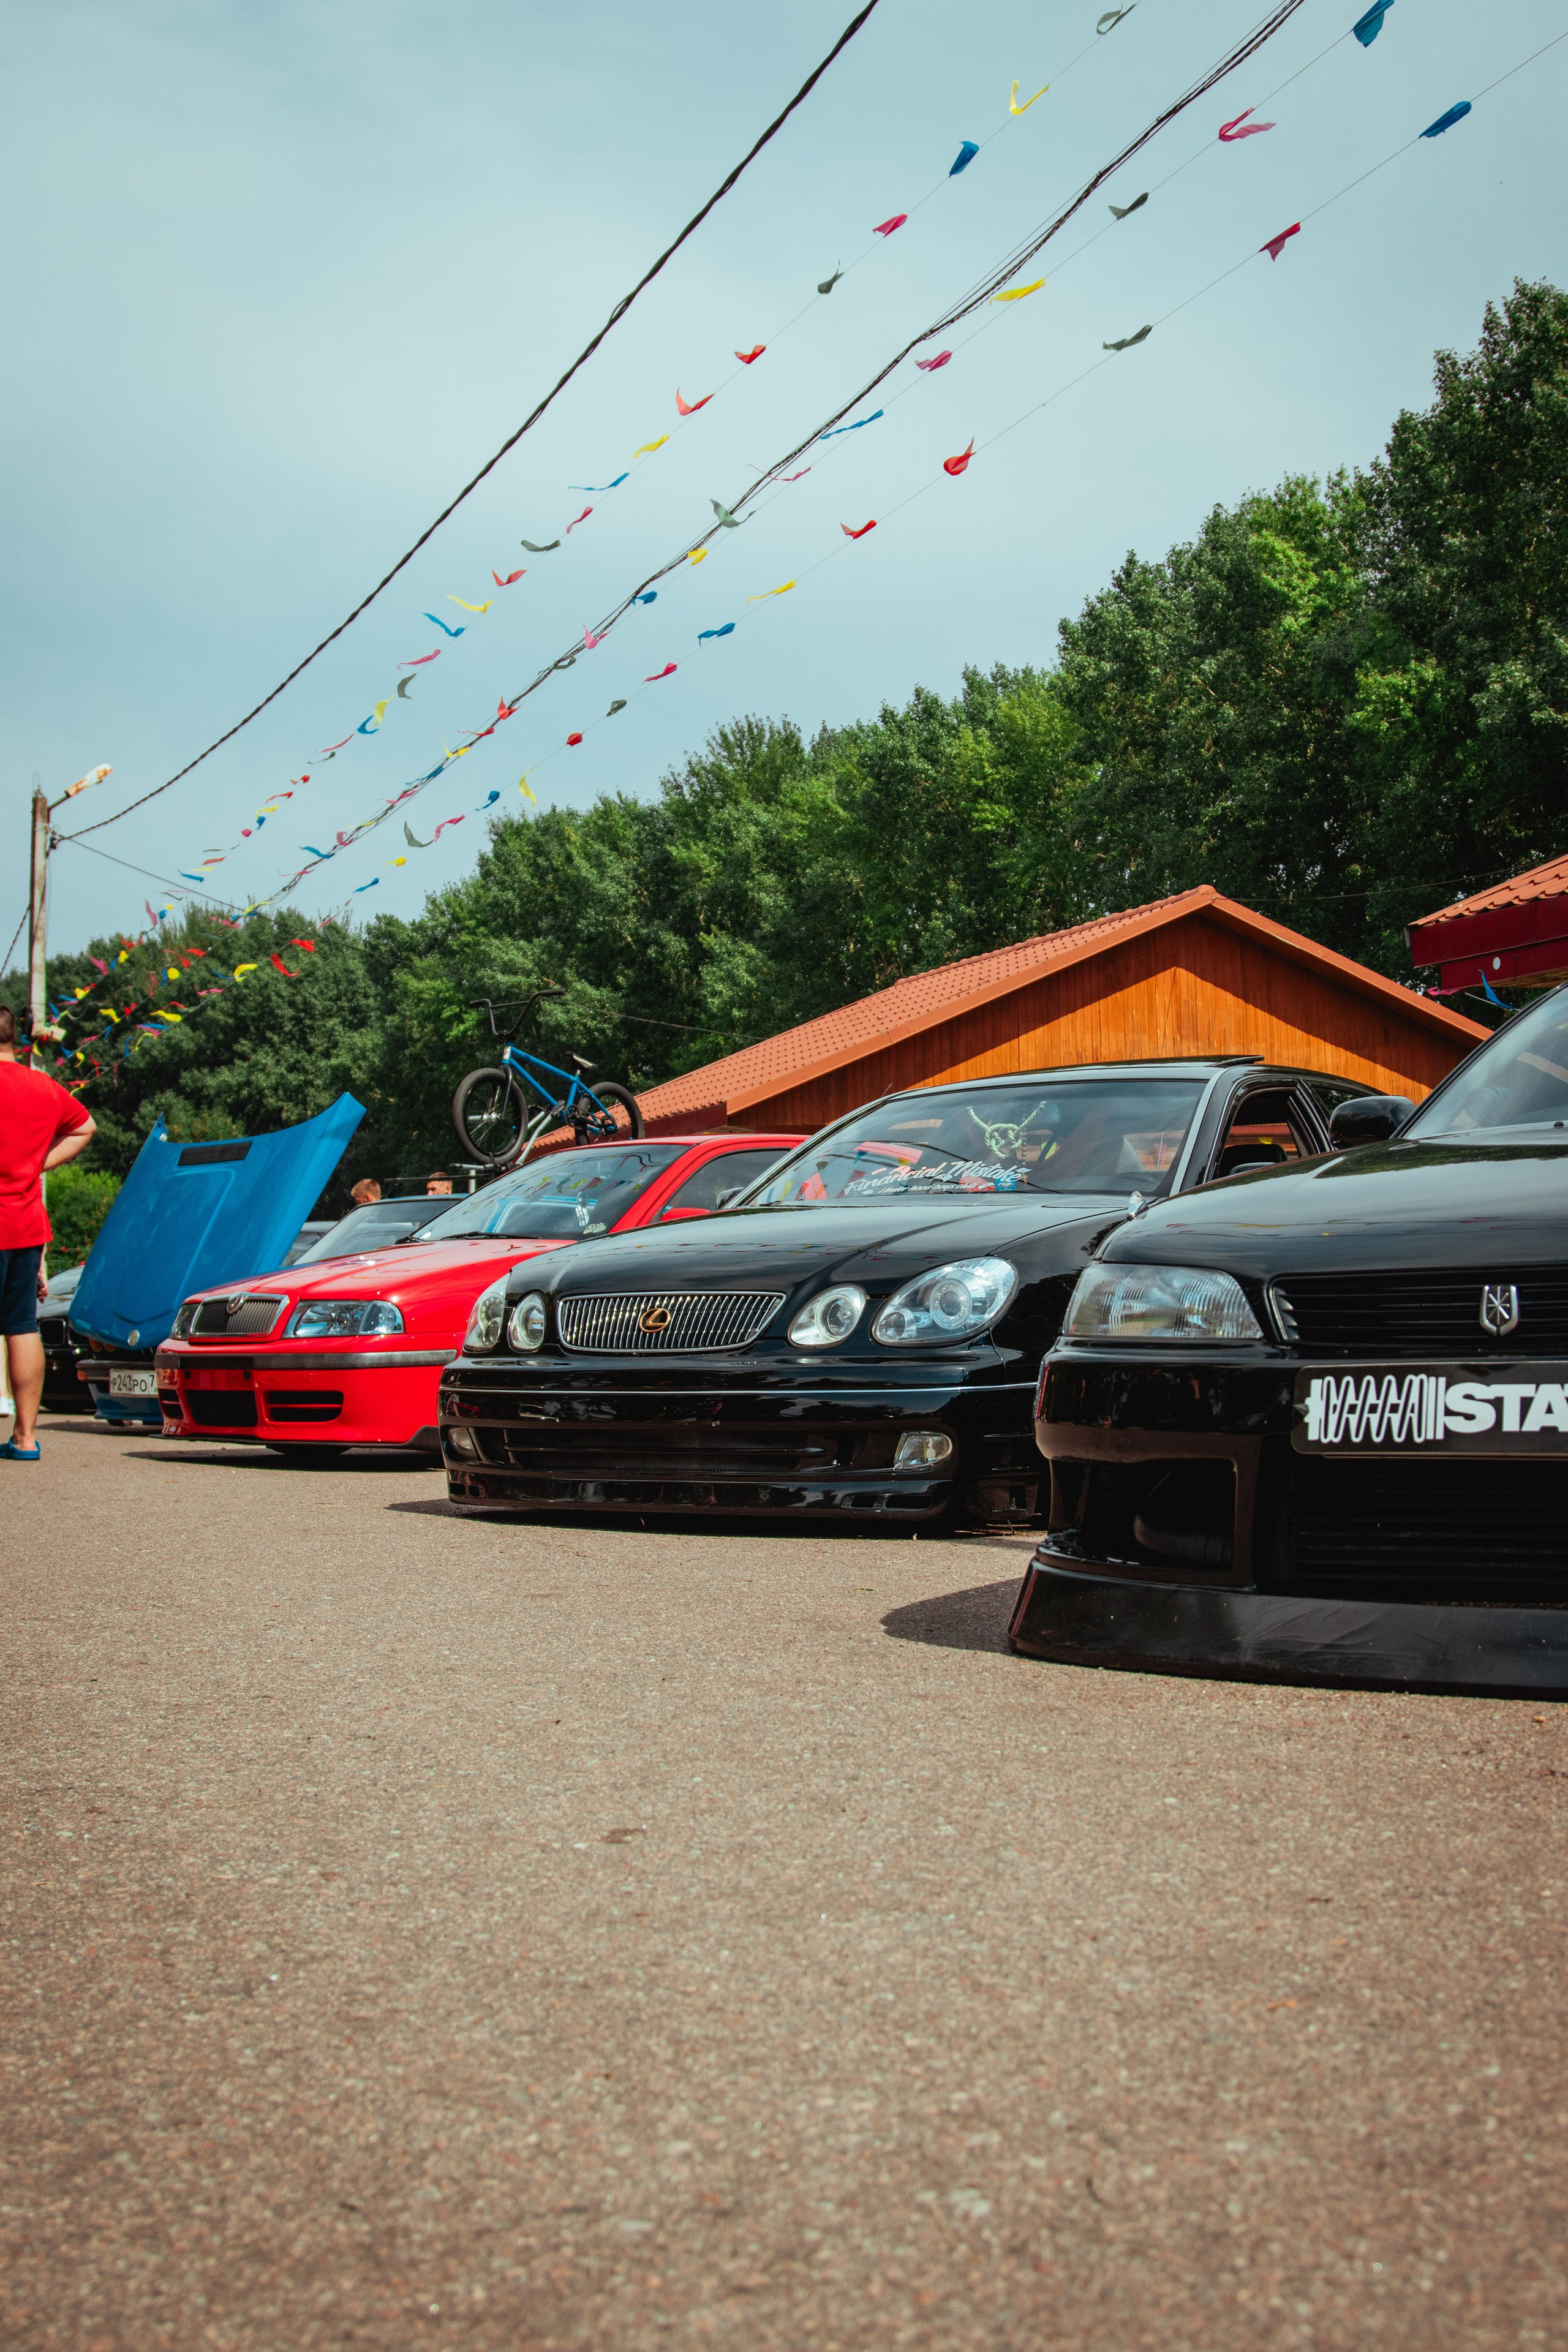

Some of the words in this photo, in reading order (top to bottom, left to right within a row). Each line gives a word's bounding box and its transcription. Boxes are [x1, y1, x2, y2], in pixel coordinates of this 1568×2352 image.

[844, 1162, 948, 1195] Financial
[947, 1161, 1022, 1183] Mistake
[932, 1183, 956, 1192] boys
[149, 1374, 155, 1387] 7
[1444, 1382, 1568, 1434] STA
